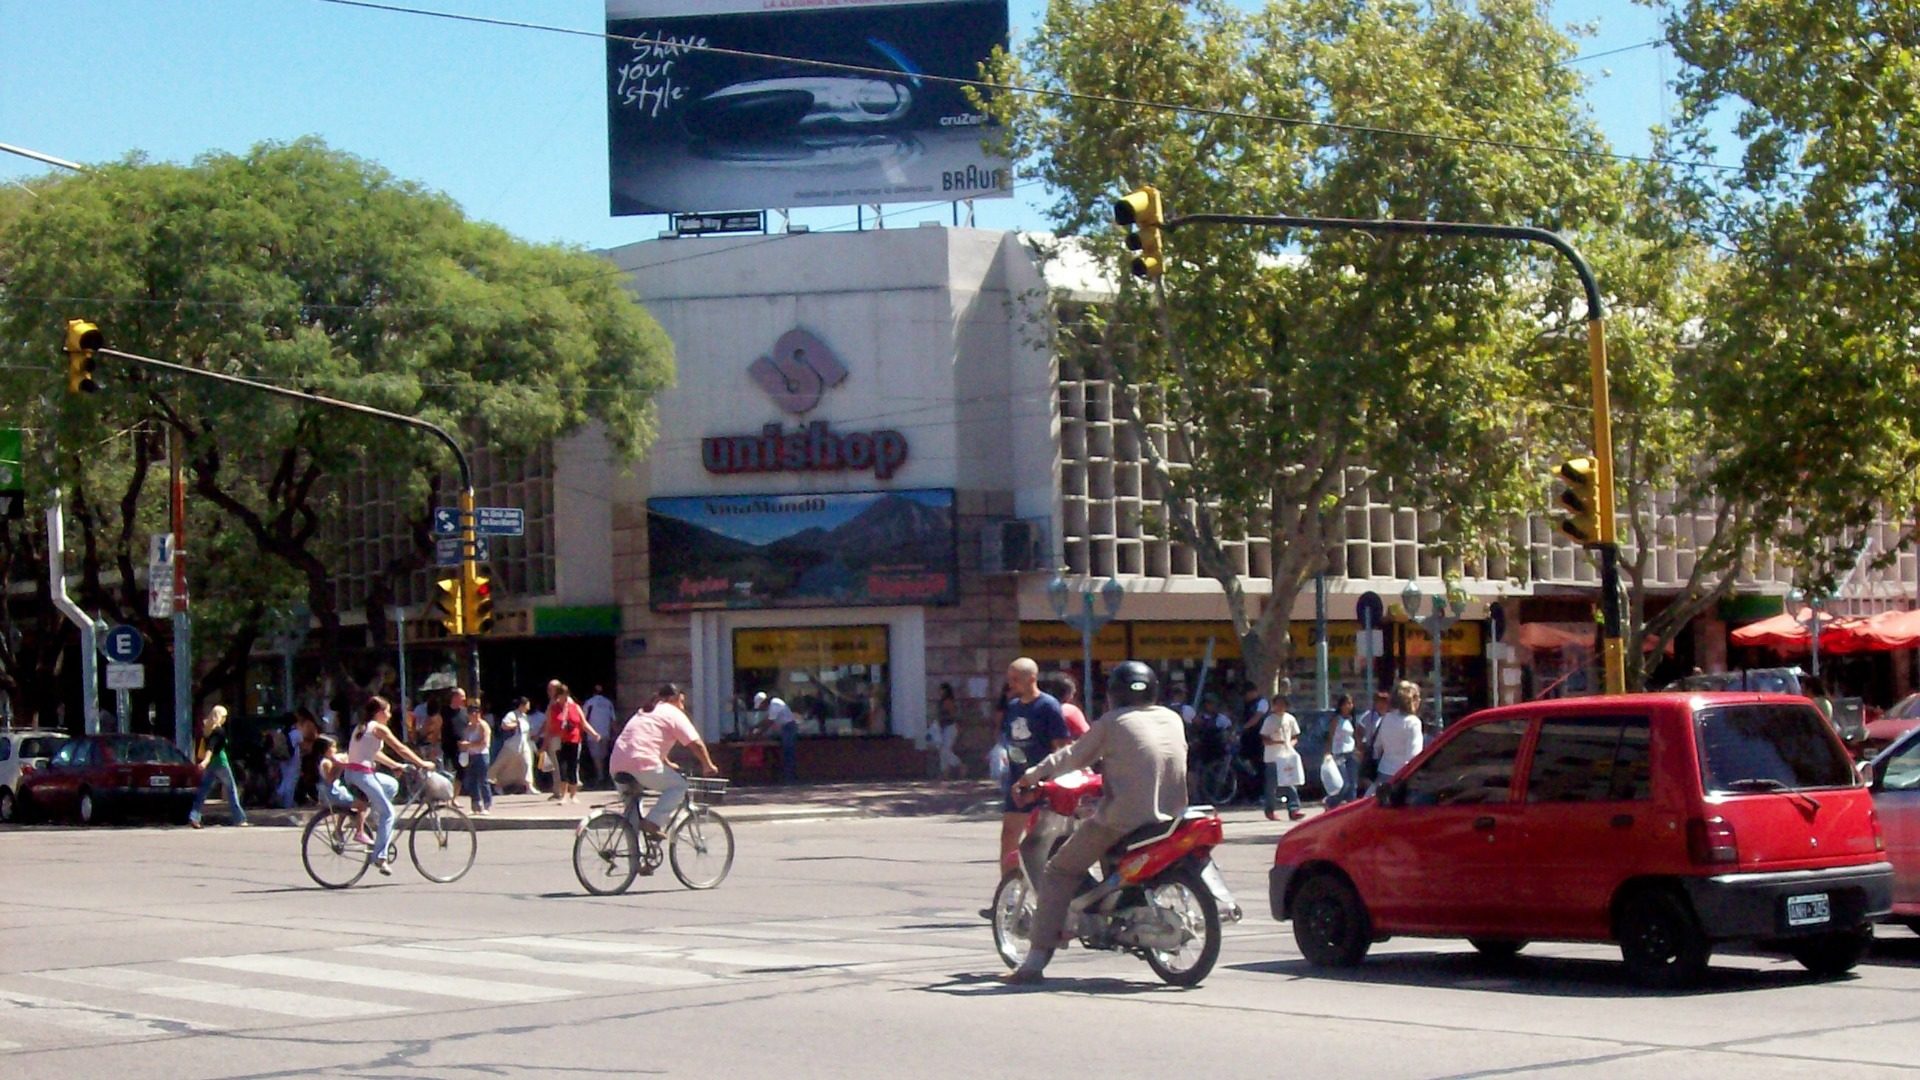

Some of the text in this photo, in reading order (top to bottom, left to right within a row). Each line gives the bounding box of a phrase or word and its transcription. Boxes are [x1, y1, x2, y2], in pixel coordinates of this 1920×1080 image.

[632, 29, 708, 62] Shave
[617, 60, 674, 95] your
[622, 78, 690, 117] style
[702, 422, 908, 480] unishop
[116, 634, 131, 654] E
